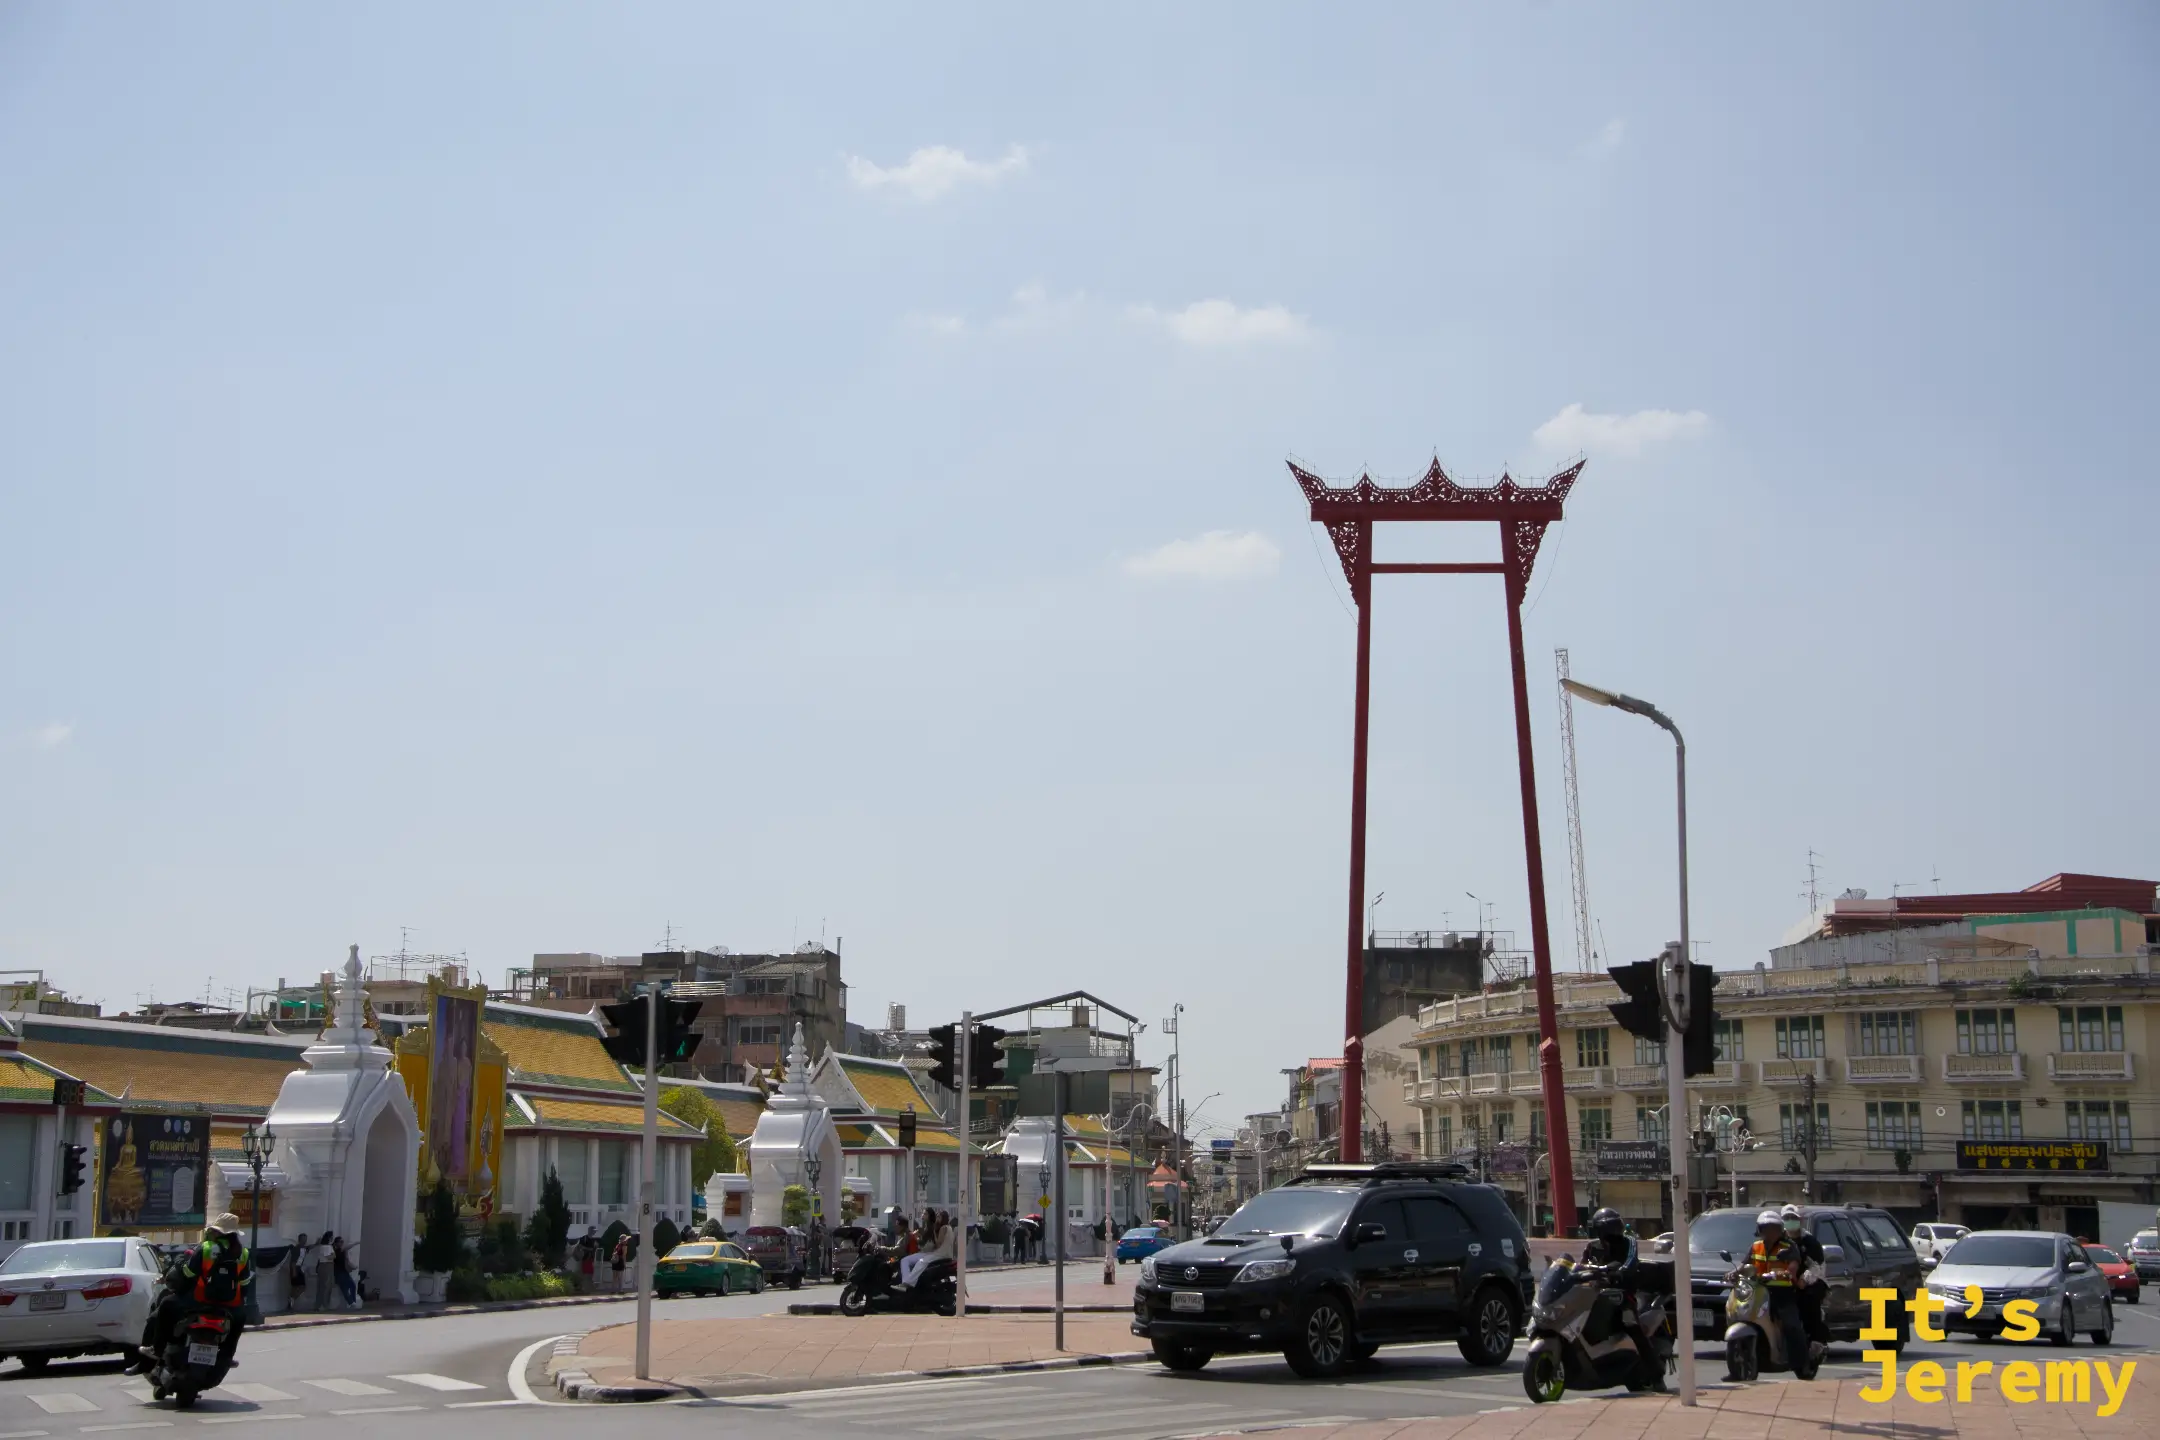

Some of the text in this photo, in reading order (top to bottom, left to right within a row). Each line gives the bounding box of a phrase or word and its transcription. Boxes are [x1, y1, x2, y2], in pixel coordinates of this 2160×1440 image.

[1964, 1143, 2098, 1158] แสงธรรมประทีป
